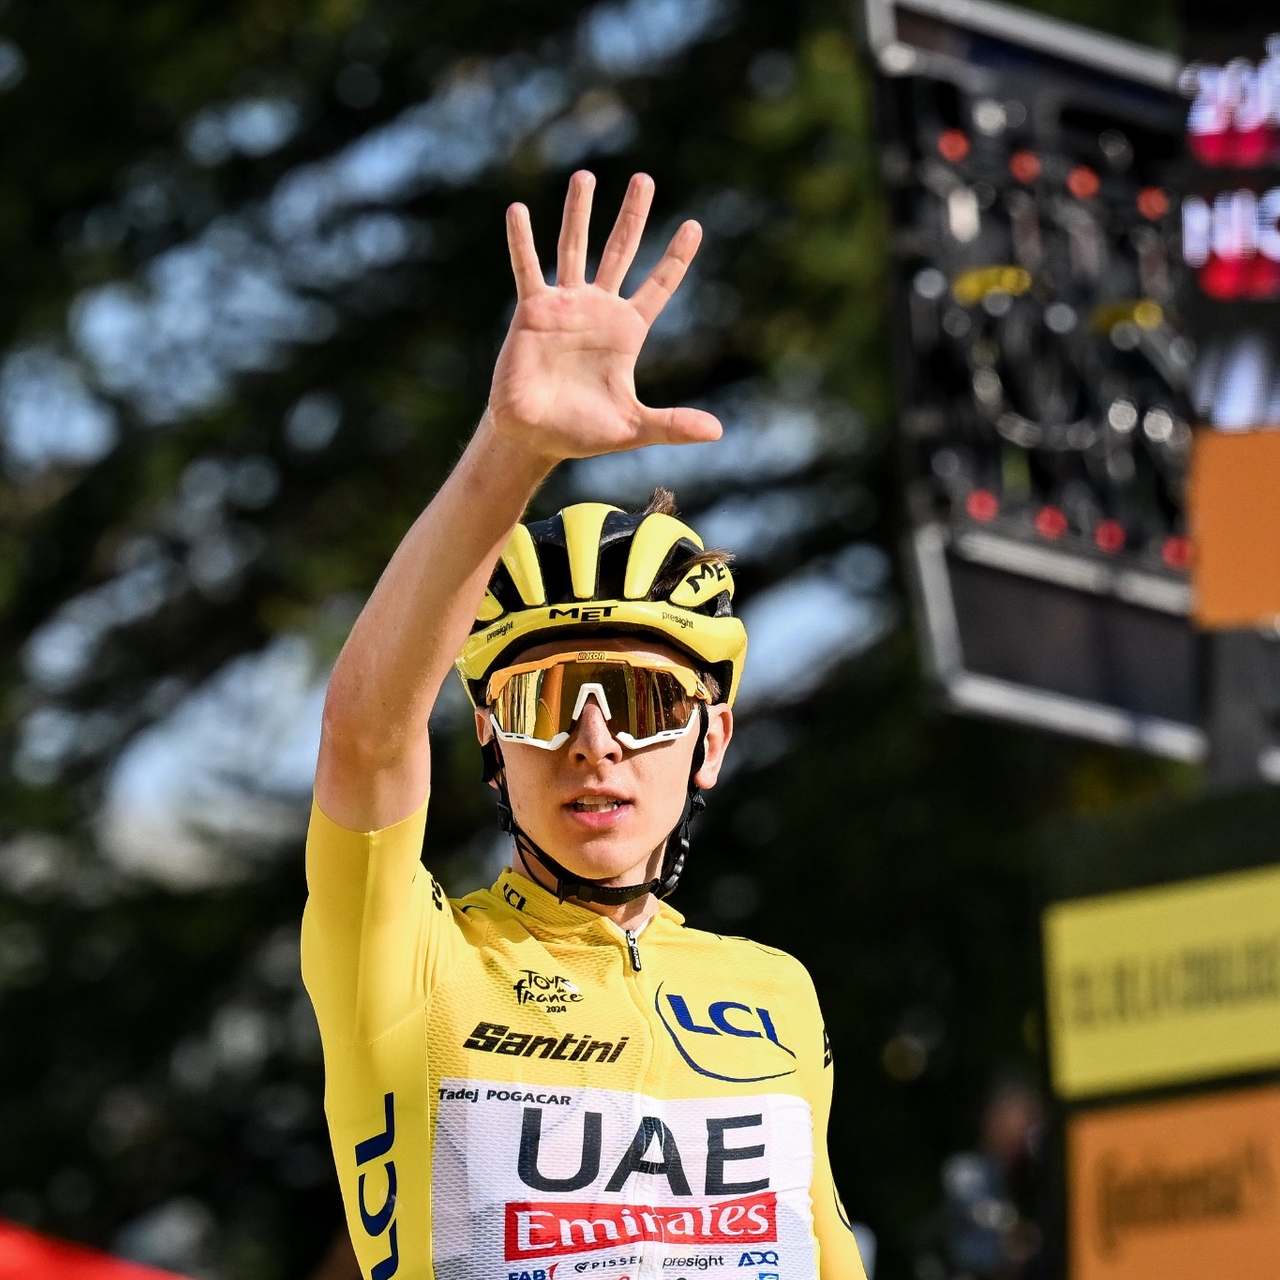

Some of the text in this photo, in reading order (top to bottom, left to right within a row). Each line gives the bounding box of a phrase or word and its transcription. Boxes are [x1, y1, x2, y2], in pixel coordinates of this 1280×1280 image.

[549, 605, 619, 623] MET
[662, 611, 695, 629] presight
[486, 620, 514, 643] presight
[545, 1005, 567, 1013] 2024
[665, 993, 797, 1060] LCL
[463, 1021, 630, 1064] Santini
[437, 1088, 572, 1105] Tadej POGACAR
[517, 1106, 770, 1197] UAE
[514, 1201, 770, 1251] Emirates
[662, 1254, 725, 1271] presight
